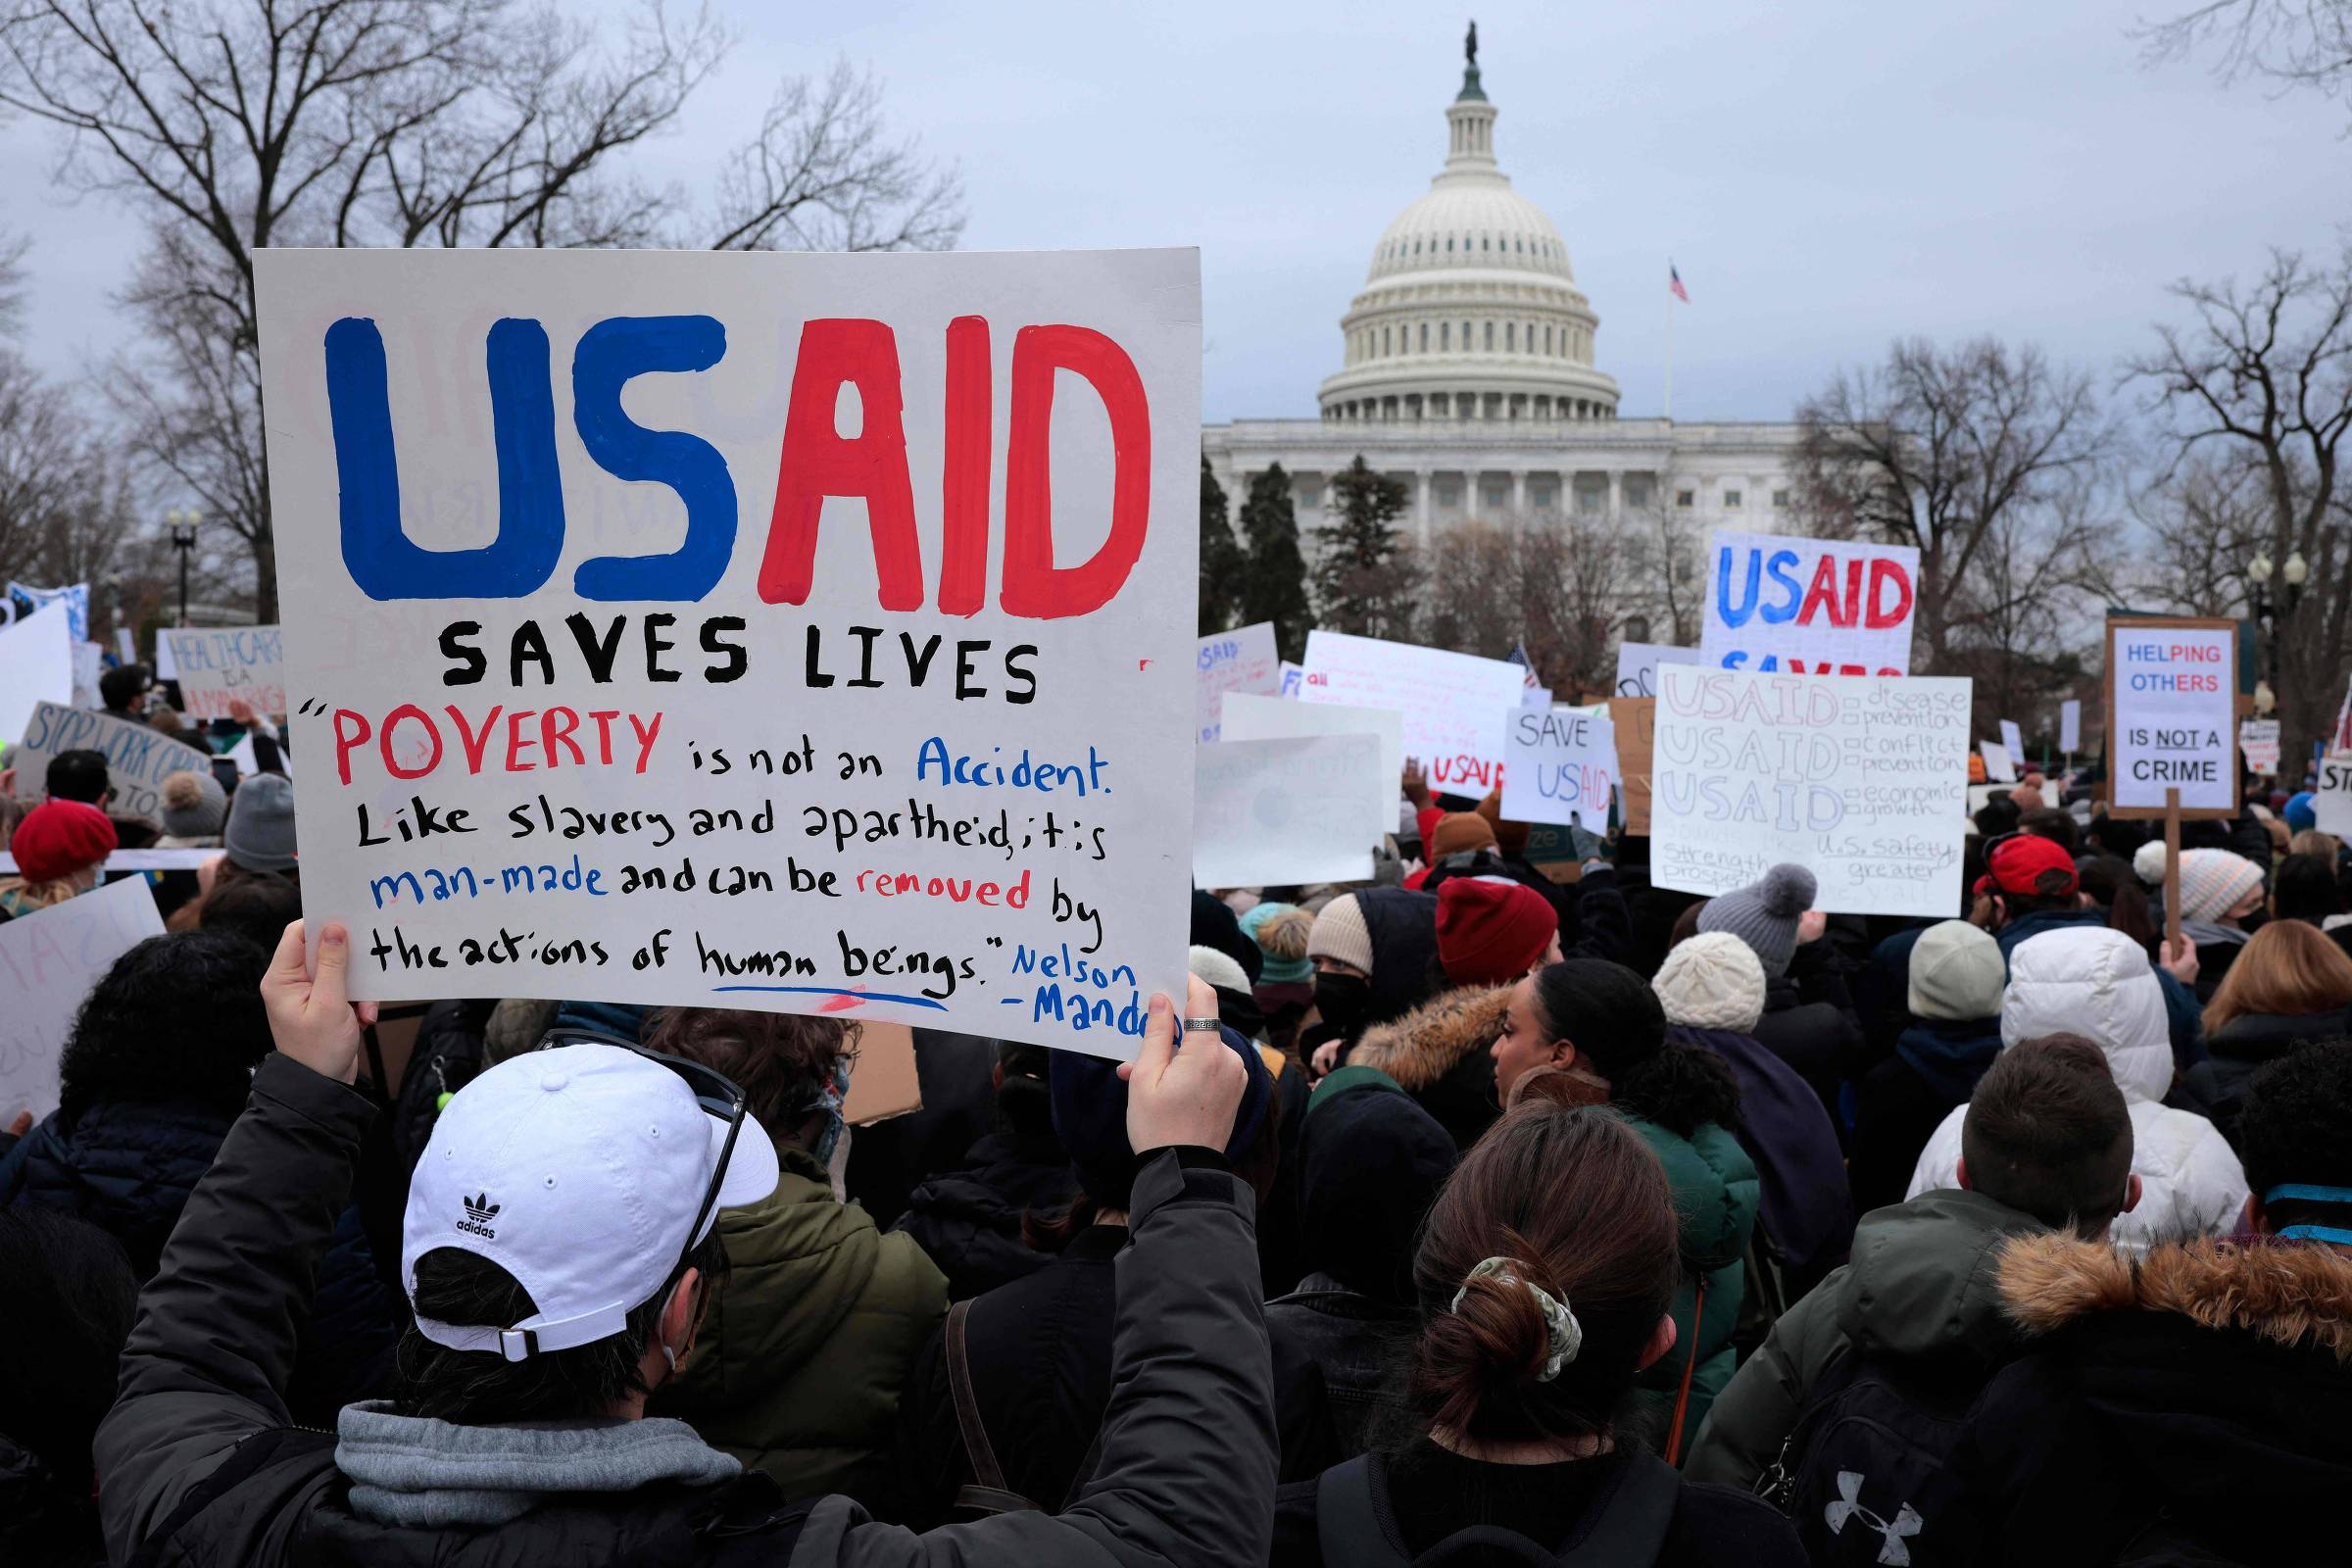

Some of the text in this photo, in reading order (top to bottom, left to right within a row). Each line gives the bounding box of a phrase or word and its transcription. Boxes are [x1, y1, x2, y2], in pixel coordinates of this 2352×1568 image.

[324, 315, 1152, 619] USAID
[1718, 547, 1912, 630] USAID
[439, 612, 1040, 706] SAVES LIVES
[2127, 644, 2222, 663] HELPING
[1665, 673, 1838, 727] USAID
[1868, 683, 1968, 712] disease
[2131, 673, 2220, 692] OTHERS
[27, 704, 96, 757] STOP
[1516, 713, 1590, 748] SAVE
[1863, 709, 1966, 733] prevention
[2130, 728, 2222, 749] IS NOT A
[688, 740, 732, 775] is
[750, 734, 815, 775] not
[838, 752, 884, 781] an
[917, 736, 1112, 797] Accident.
[1661, 725, 1840, 783] USAID
[1864, 733, 1964, 755] conflict
[1862, 755, 1963, 778] prevention
[2132, 760, 2218, 782] CRIME
[1537, 762, 1612, 811] USAID
[2321, 764, 2352, 792] ST
[125, 784, 159, 817] TO
[1661, 770, 1844, 832] USAID
[1864, 781, 1962, 804] economic
[1862, 803, 1942, 824] growth
[358, 795, 479, 848] Like
[508, 794, 675, 847] slavery
[689, 799, 774, 837] and
[804, 798, 1013, 860] apartheid,
[1817, 834, 1866, 856] U.S.
[1848, 862, 1934, 886] greater
[370, 855, 1103, 955] man-made and can be removed by
[369, 926, 449, 972] the
[459, 928, 610, 967] actions
[632, 928, 673, 971] of
[696, 930, 817, 978] human
[1012, 943, 1137, 986] Nelson
[1002, 983, 1182, 1049] -Mand
[456, 1220, 496, 1240] adidas
